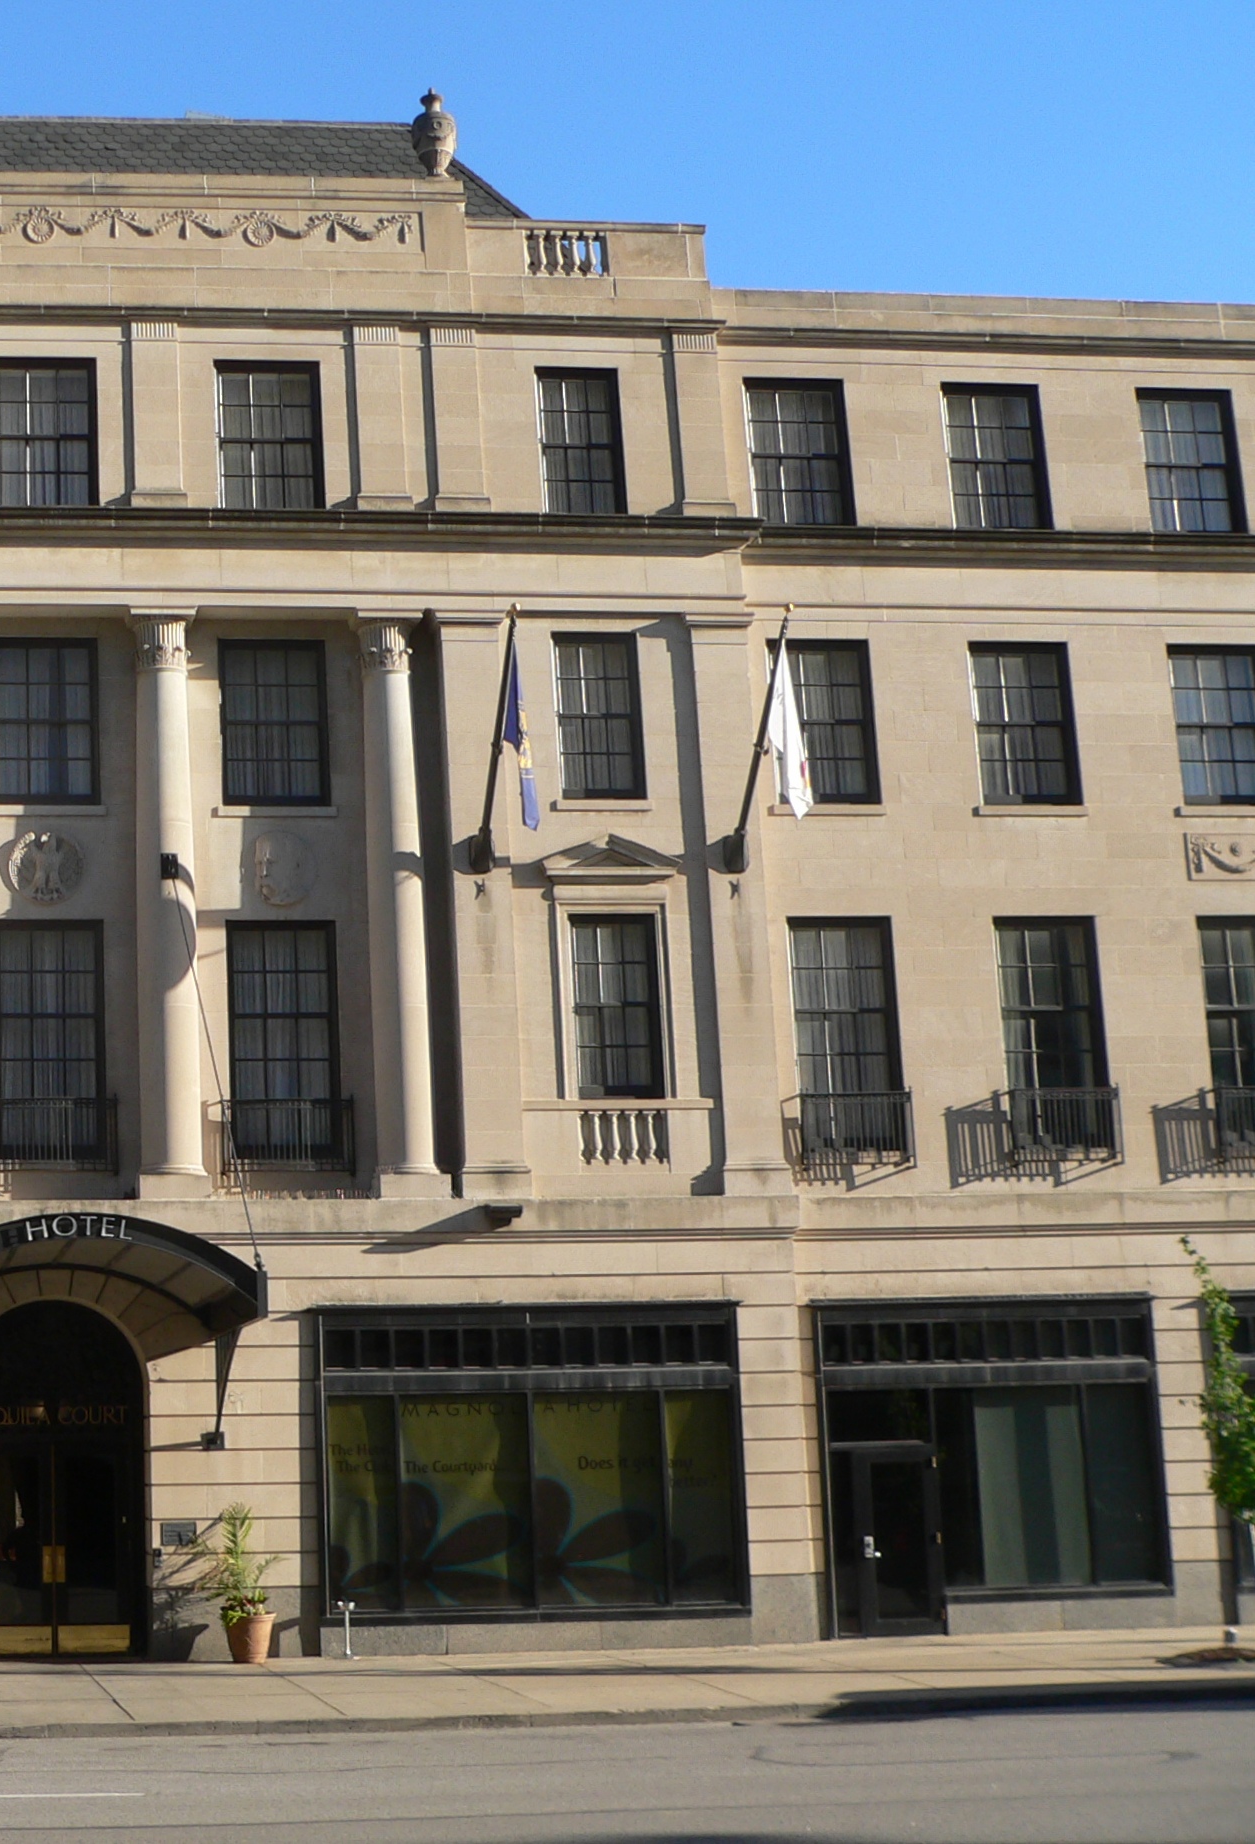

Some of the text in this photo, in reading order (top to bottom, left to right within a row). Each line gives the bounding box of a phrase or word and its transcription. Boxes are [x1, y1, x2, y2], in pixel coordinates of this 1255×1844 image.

[26, 1215, 133, 1241] HOTEL
[58, 1404, 128, 1425] COURT
[403, 1460, 428, 1474] The
[577, 1454, 614, 1470] Does
